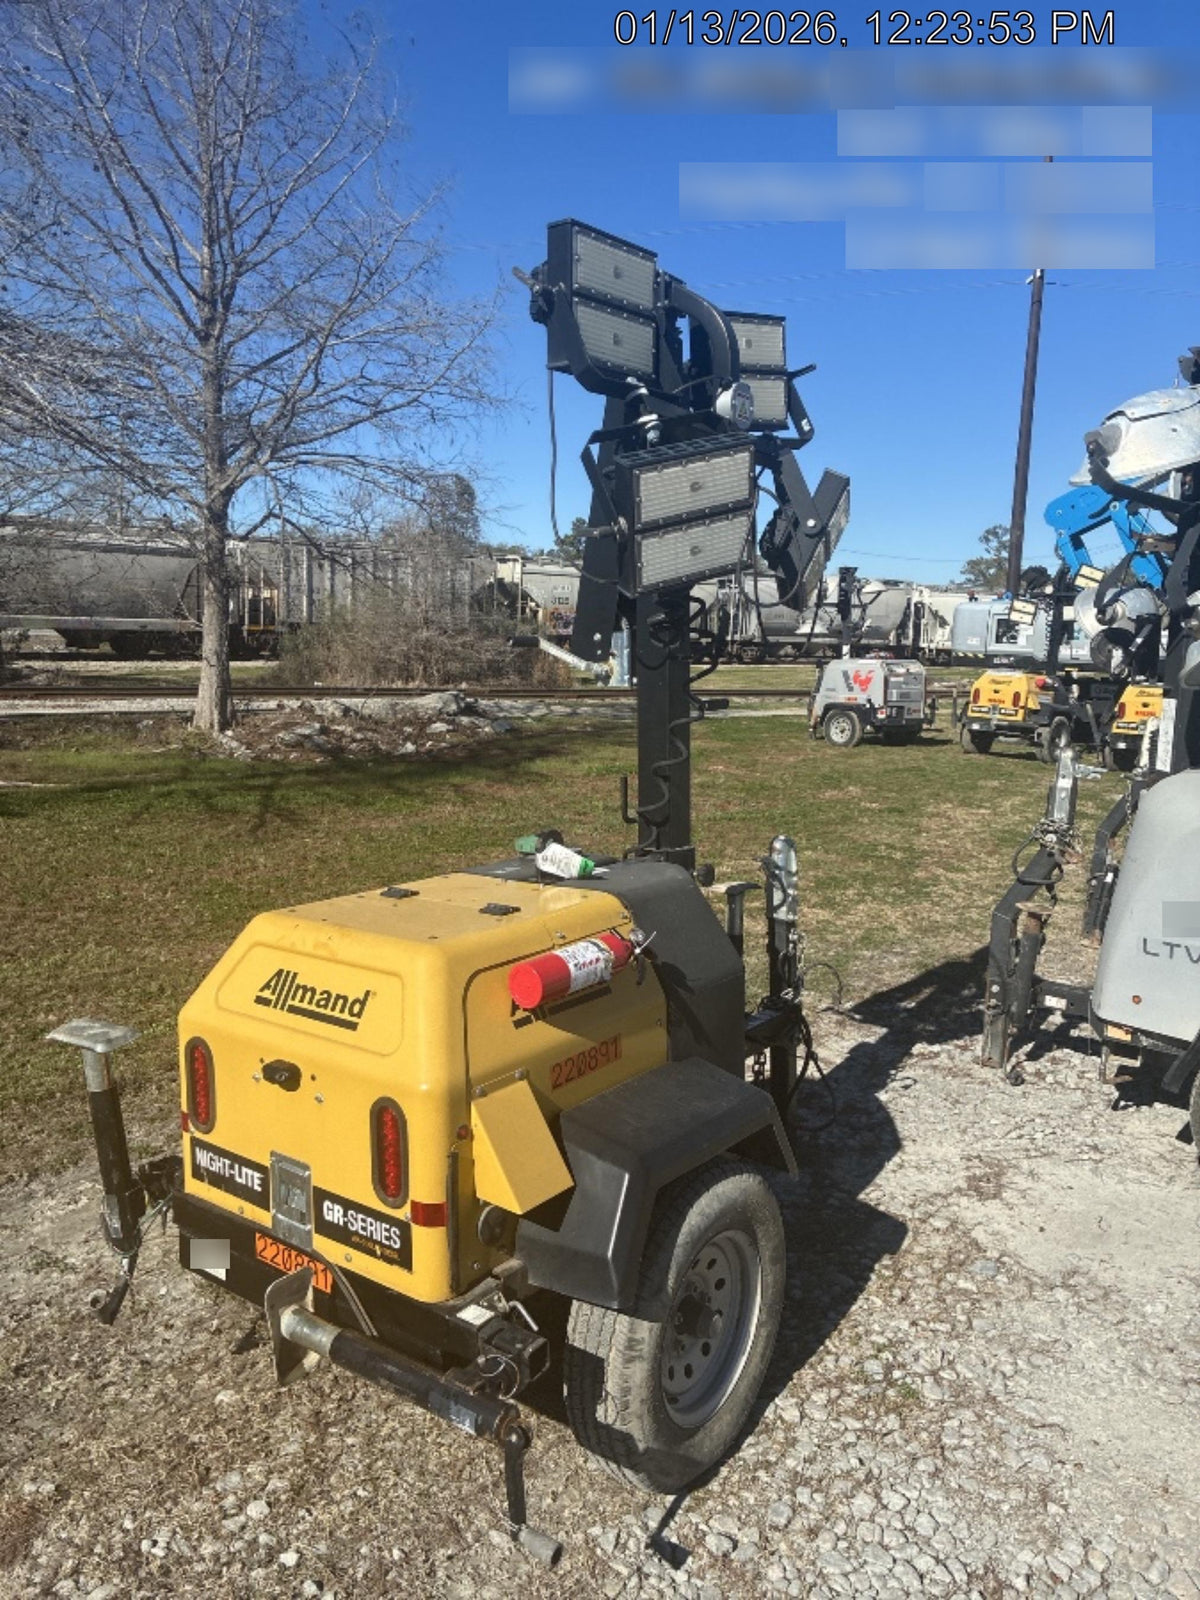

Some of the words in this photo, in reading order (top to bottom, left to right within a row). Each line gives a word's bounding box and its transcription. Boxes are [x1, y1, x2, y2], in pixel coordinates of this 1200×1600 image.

[258, 968, 371, 1019] Allmand
[552, 1033, 618, 1089] 220891
[195, 1146, 264, 1192] NIGHT-LITE
[323, 1200, 401, 1249] GR-SERIES
